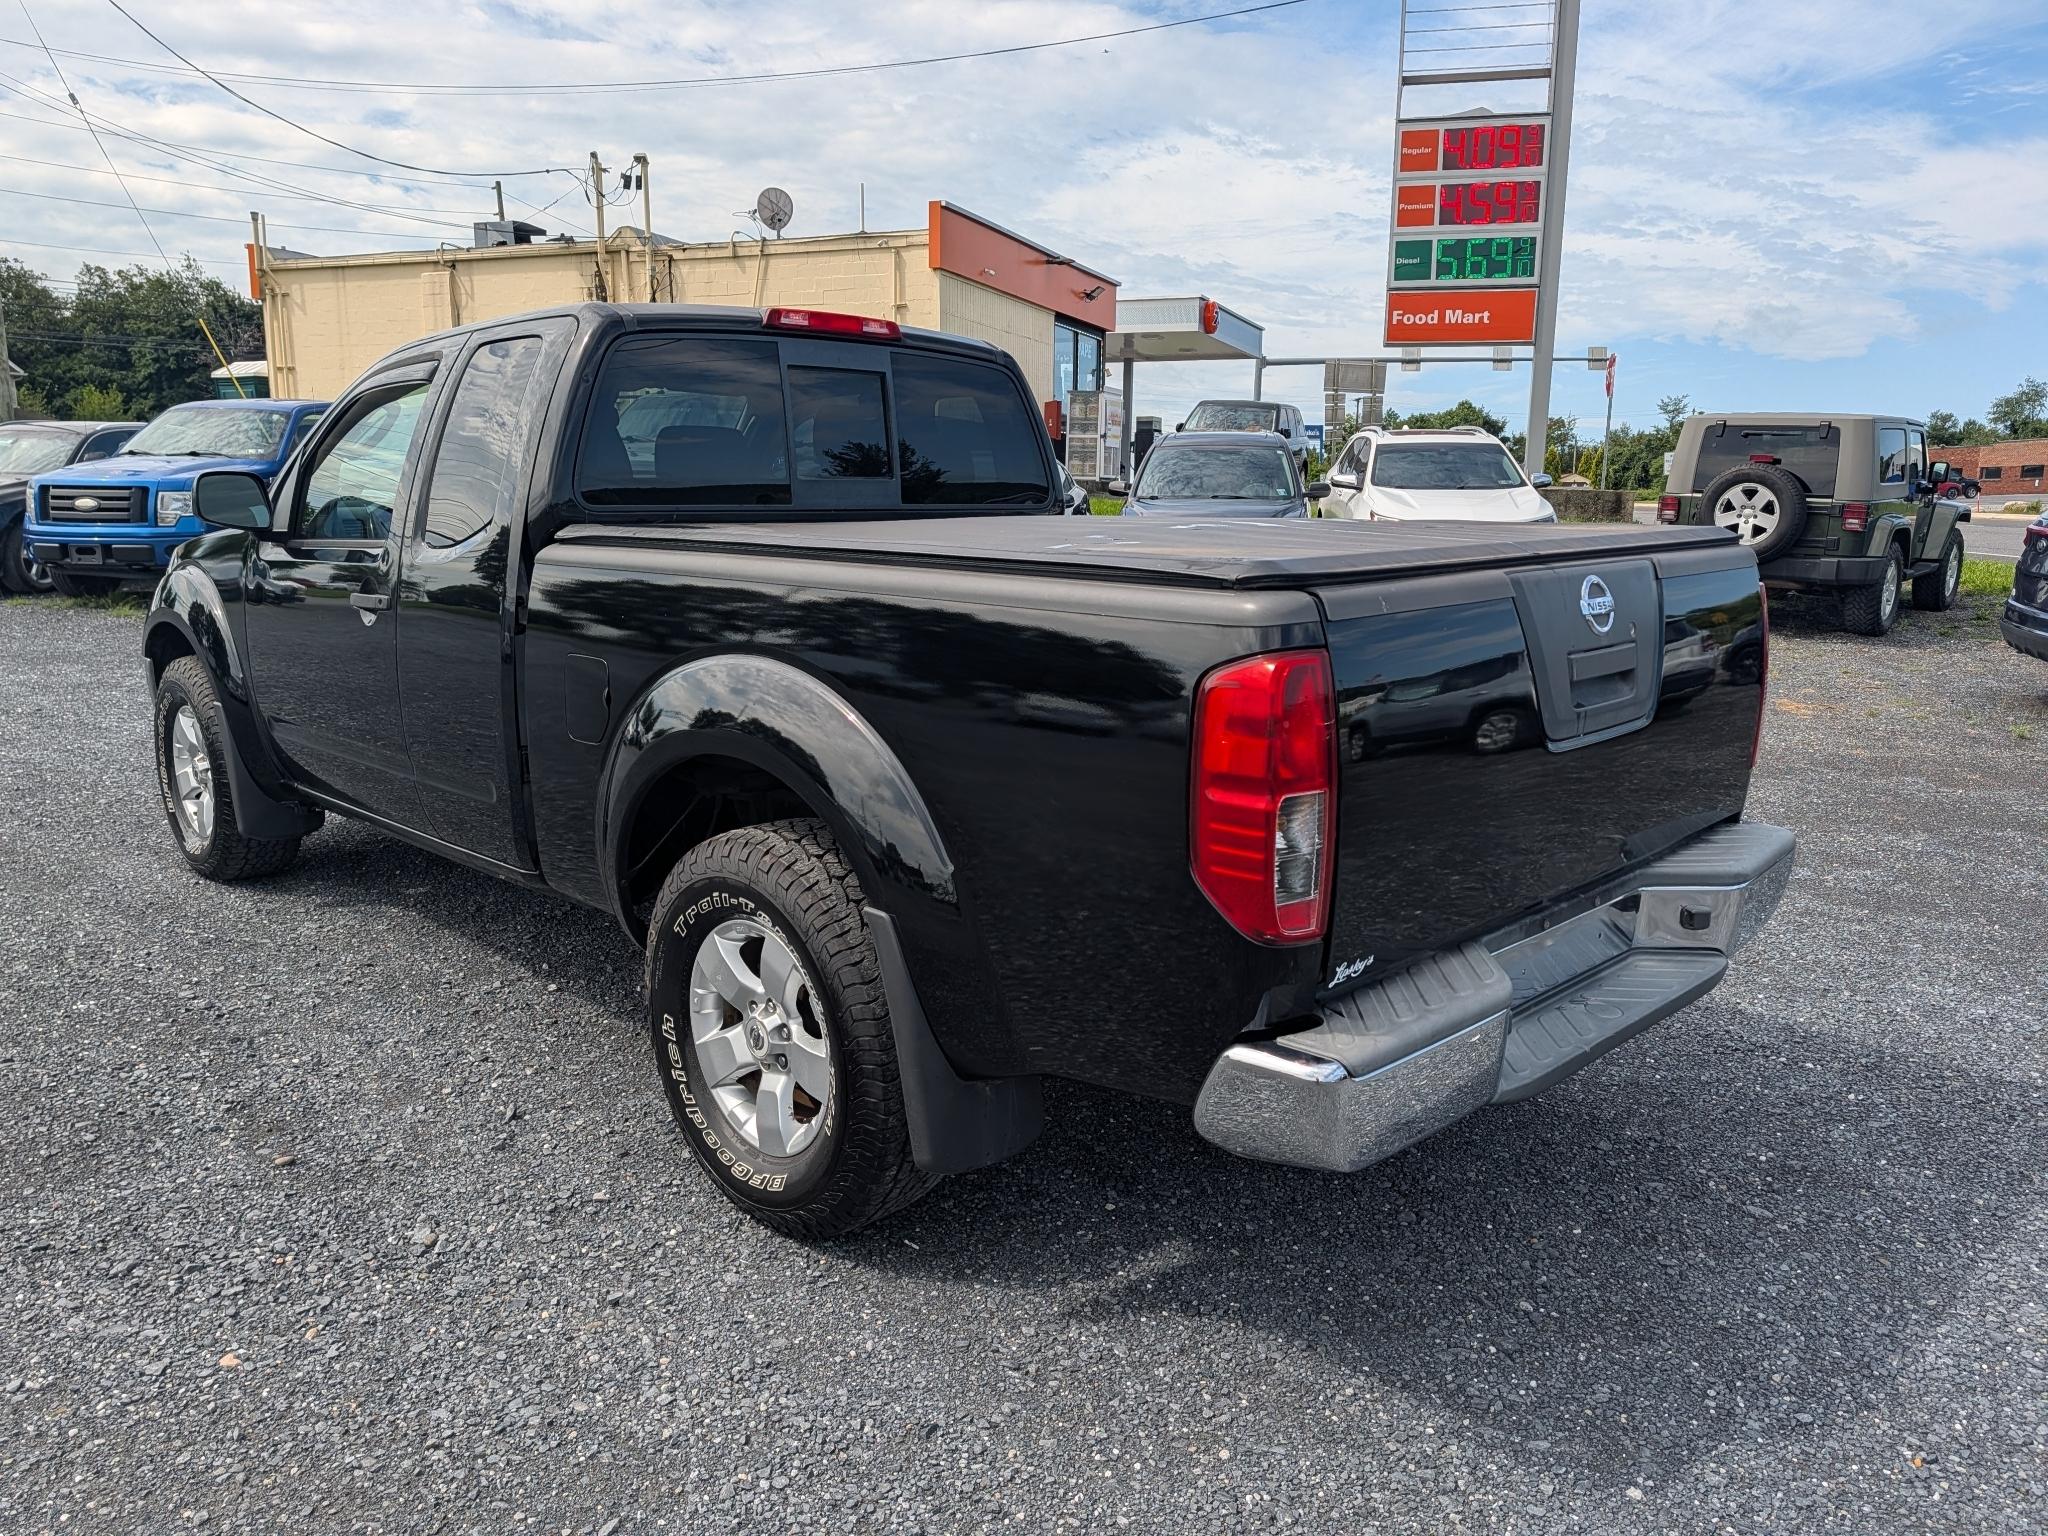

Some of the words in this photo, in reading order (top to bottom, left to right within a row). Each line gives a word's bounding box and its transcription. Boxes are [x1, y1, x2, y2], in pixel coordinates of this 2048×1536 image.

[1402, 146, 1432, 155] Regular
[1399, 202, 1434, 211] Premium
[1396, 257, 1420, 265] Diesel
[1391, 309, 1439, 325] Food
[1445, 309, 1491, 324] Mart
[662, 1013, 788, 1191] BFGoodrich
